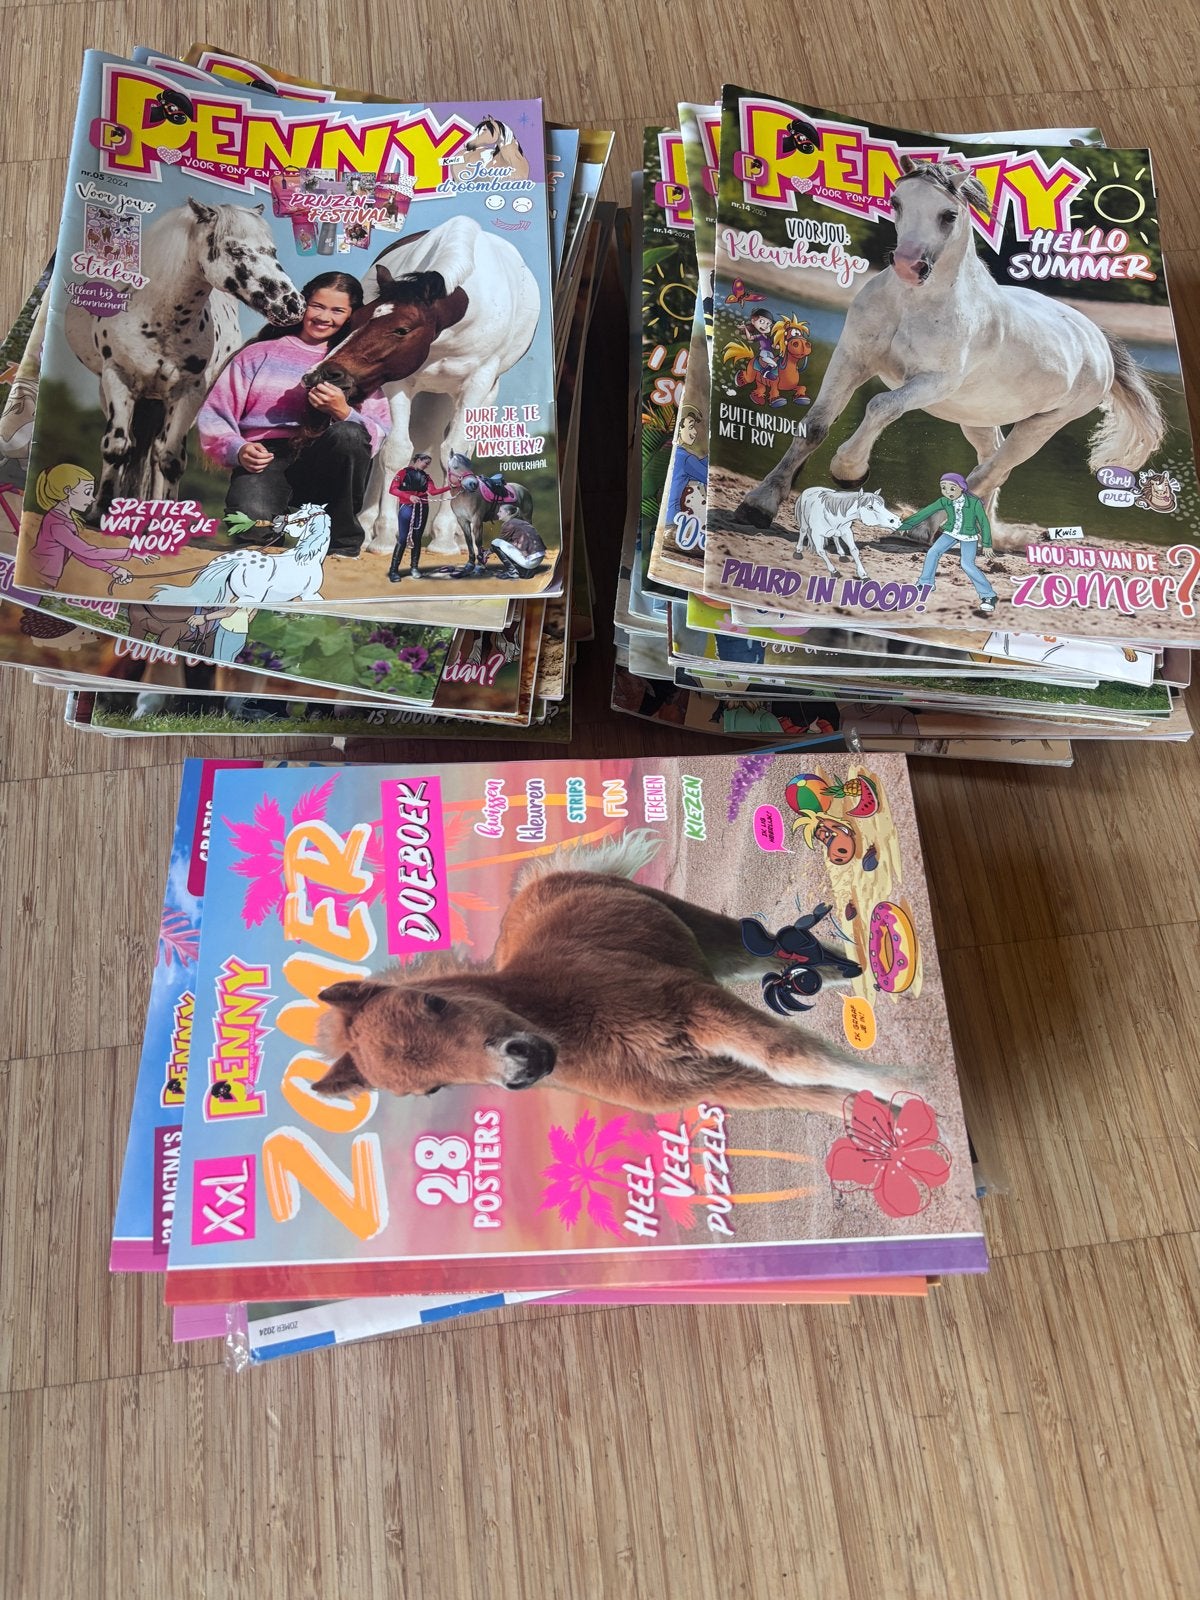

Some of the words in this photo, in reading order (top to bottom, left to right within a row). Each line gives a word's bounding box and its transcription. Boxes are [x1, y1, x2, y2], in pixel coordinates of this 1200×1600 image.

[112, 74, 465, 191] PENNY
[80, 169, 105, 181] nr.05
[106, 177, 129, 189] 2024
[184, 157, 215, 172] VOOR
[219, 163, 250, 177] PONY
[254, 168, 270, 179] EN
[460, 161, 515, 181] Jouw
[77, 183, 116, 203] Voor
[437, 176, 536, 193] droombaan
[815, 186, 842, 199] VOOR
[845, 192, 873, 205] PONY
[876, 198, 892, 207] EN
[290, 193, 377, 209] PRIJZEN-
[731, 201, 751, 212] nr.14
[308, 207, 391, 224] FESTIVAL
[653, 226, 673, 235] nr.14
[787, 219, 819, 239] VOOR
[820, 223, 851, 245] JOU:
[1030, 229, 1129, 254] HELLO
[723, 231, 867, 287] Kleurboekje
[1009, 254, 1157, 280] SUMMER
[66, 282, 98, 297] Alleen
[98, 286, 117, 300] bij
[70, 293, 130, 312] abonnement
[464, 407, 497, 424] DURF
[502, 406, 519, 422] JE
[522, 405, 540, 421] TE
[720, 402, 807, 439] BUITENRIJDEN
[464, 423, 528, 441] SPRINGEN,
[719, 420, 746, 441] MET
[750, 430, 776, 449] ROY
[477, 437, 545, 458] MYSTERY?
[499, 459, 547, 472] FOTOVERHAAL
[1100, 467, 1132, 484] Pony
[1102, 490, 1131, 503] pret
[100, 514, 145, 532] WAT
[188, 519, 215, 534] JE
[1054, 528, 1078, 538] Kwis
[129, 529, 185, 552] NOU?
[1028, 545, 1066, 567] HOU
[1068, 547, 1098, 569] JIJ
[1099, 550, 1134, 571] VAN
[1134, 553, 1160, 572] DE
[722, 559, 801, 597] PAARD
[807, 575, 838, 605] IN
[840, 580, 933, 612] NOOD!
[475, 779, 508, 837] kwissen
[518, 779, 545, 842] kleuren
[568, 778, 583, 822] STRIPS
[603, 780, 628, 817] FUN
[644, 776, 666, 822] TEKENEN
[683, 776, 706, 840] KIEZEN
[397, 780, 441, 942] DOEBOEK
[206, 958, 269, 1119] PENNY
[413, 1134, 473, 1206] 28
[472, 1109, 502, 1228] POSTERS
[658, 1123, 696, 1198] VEEL
[697, 1103, 734, 1237] PUZZELS
[623, 1156, 658, 1237] HEEL
